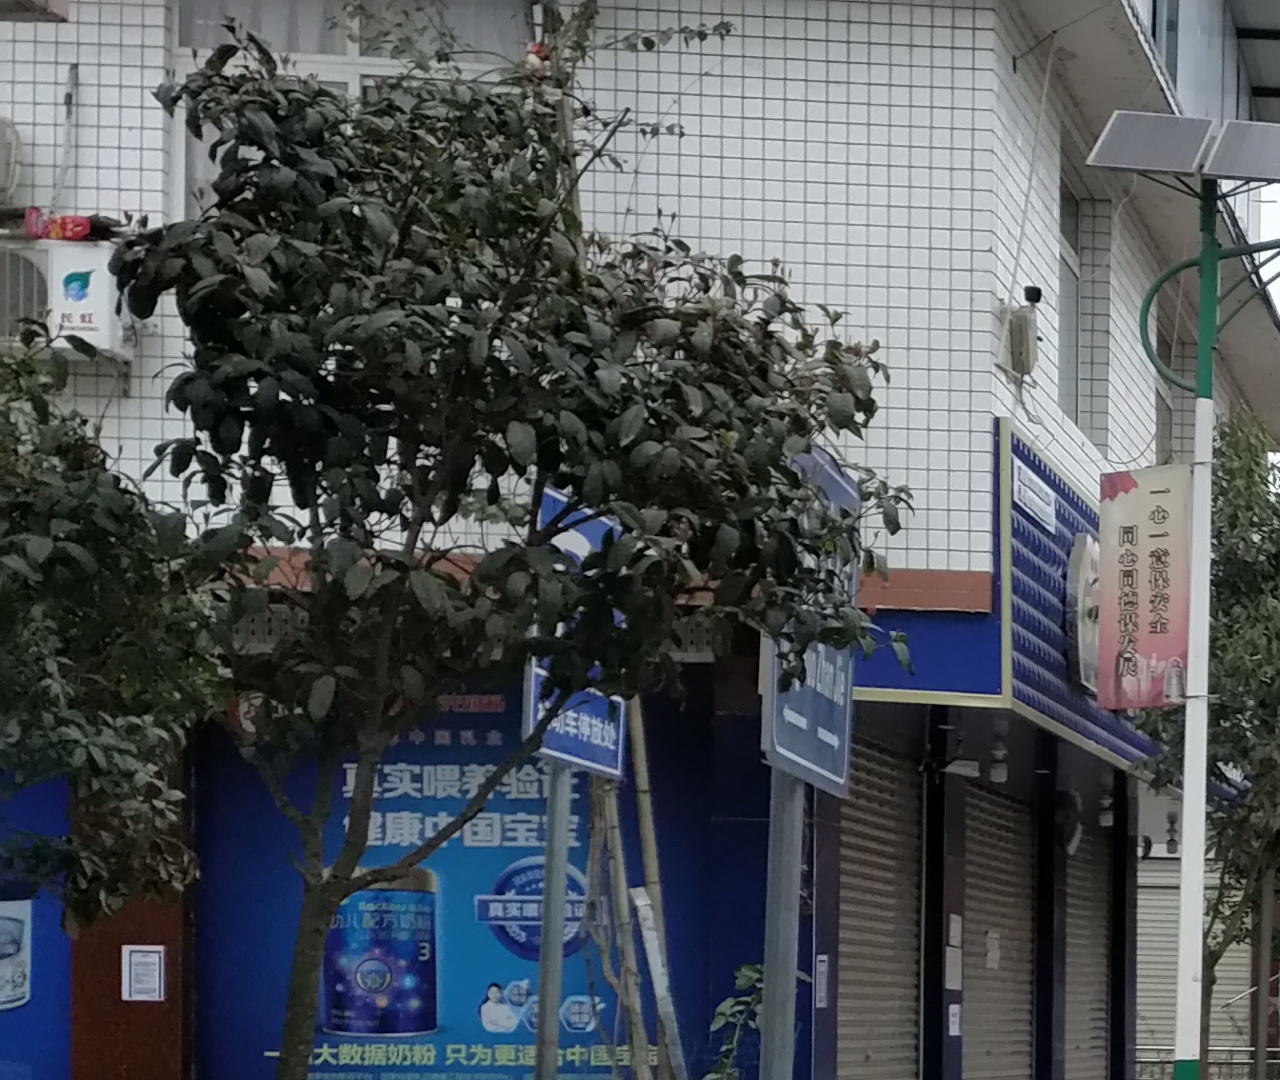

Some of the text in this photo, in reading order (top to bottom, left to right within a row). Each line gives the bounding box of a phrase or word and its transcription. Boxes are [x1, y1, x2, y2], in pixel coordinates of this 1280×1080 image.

[1118, 525, 1139, 677] 同心同德谋发展
[1148, 488, 1171, 634] 一心一意保安全
[418, 942, 431, 962] 3
[264, 1043, 659, 1066] 一大数据奶粉 只为更适中国宝
